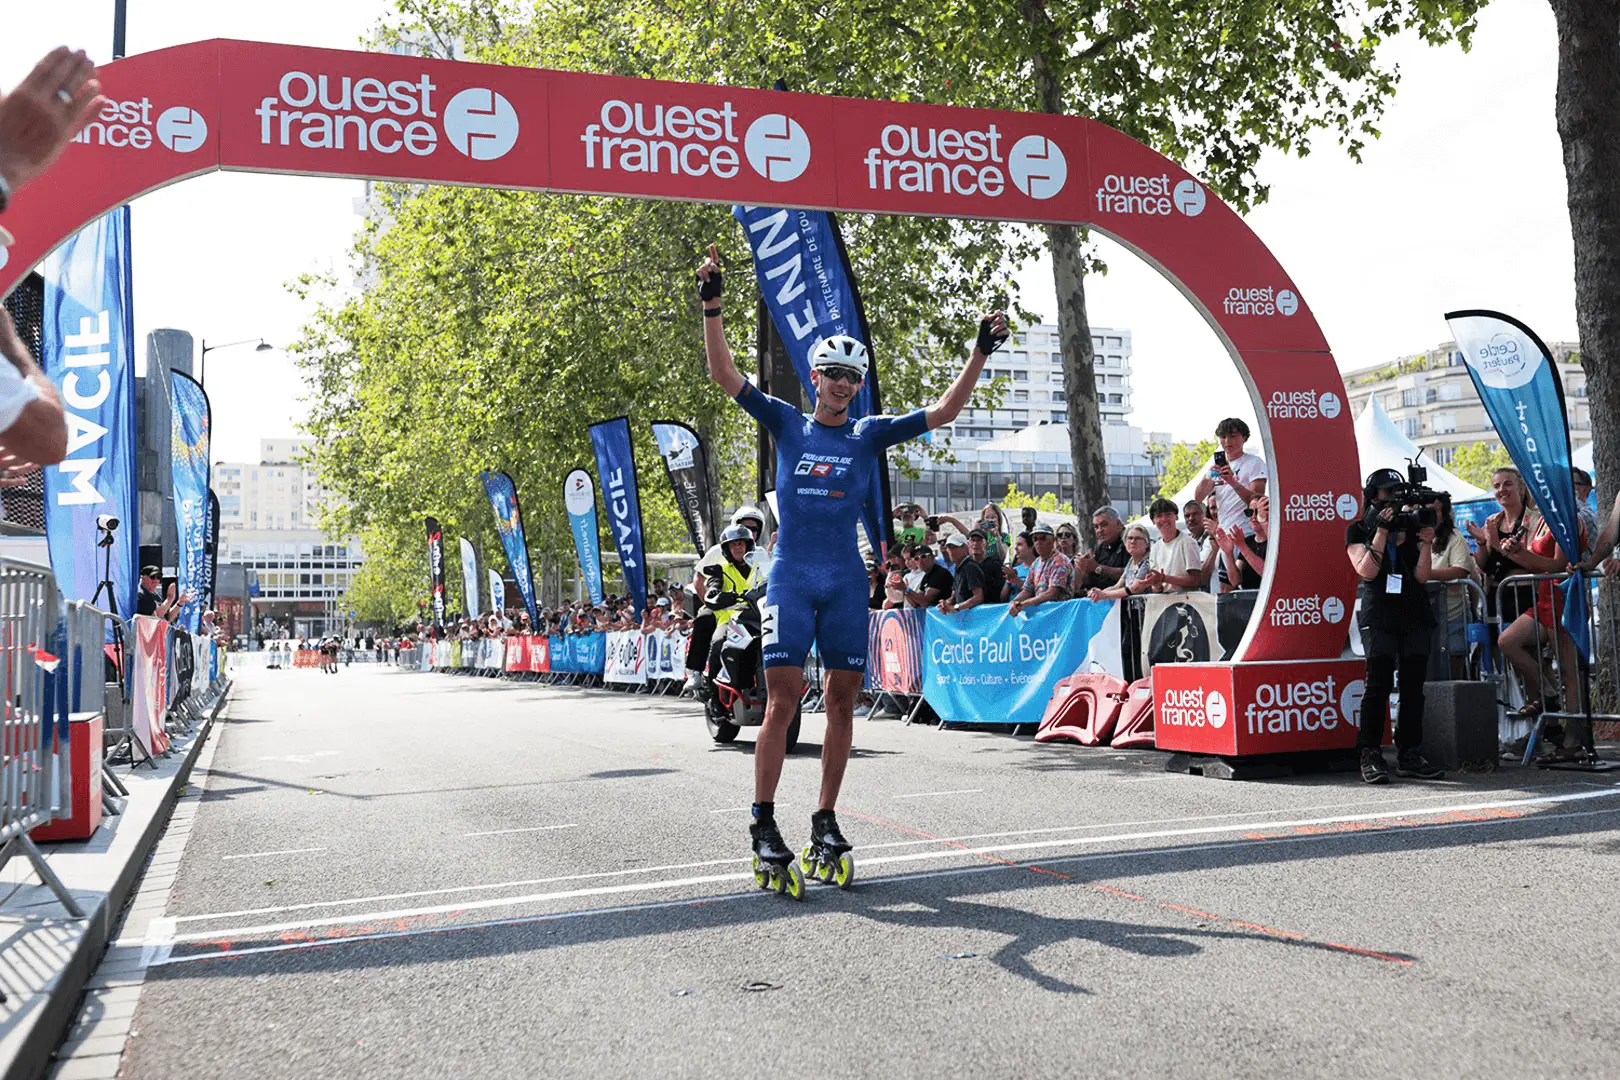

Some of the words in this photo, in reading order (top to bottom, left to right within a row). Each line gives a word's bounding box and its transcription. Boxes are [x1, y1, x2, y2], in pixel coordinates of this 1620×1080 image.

[279, 71, 436, 118] ouest
[98, 96, 152, 125] est
[601, 100, 738, 142] ouest
[69, 122, 152, 149] nce
[255, 97, 437, 156] france
[580, 124, 740, 178] france
[881, 124, 1003, 162] ouest
[864, 148, 1004, 196] france
[1104, 174, 1170, 196] ouest
[1095, 188, 1172, 216] france
[808, 234, 819, 253] DE
[811, 256, 841, 320] PARTENAIRE
[1229, 286, 1274, 302] ouest
[1223, 297, 1274, 316] france
[1266, 401, 1318, 418] france
[1272, 389, 1317, 405] ouest
[801, 452, 854, 465] POWERSLIDE
[1284, 504, 1335, 521] france
[1290, 491, 1334, 507] ouest
[1276, 594, 1320, 612] ouest
[1270, 608, 1321, 626] france
[932, 638, 974, 665] Cercle
[979, 633, 1012, 663] Paul
[1019, 632, 1060, 662] Bert
[1164, 686, 1204, 709] ouest
[1256, 675, 1337, 708] ouest
[1161, 700, 1206, 728] france
[1244, 703, 1338, 734] france
